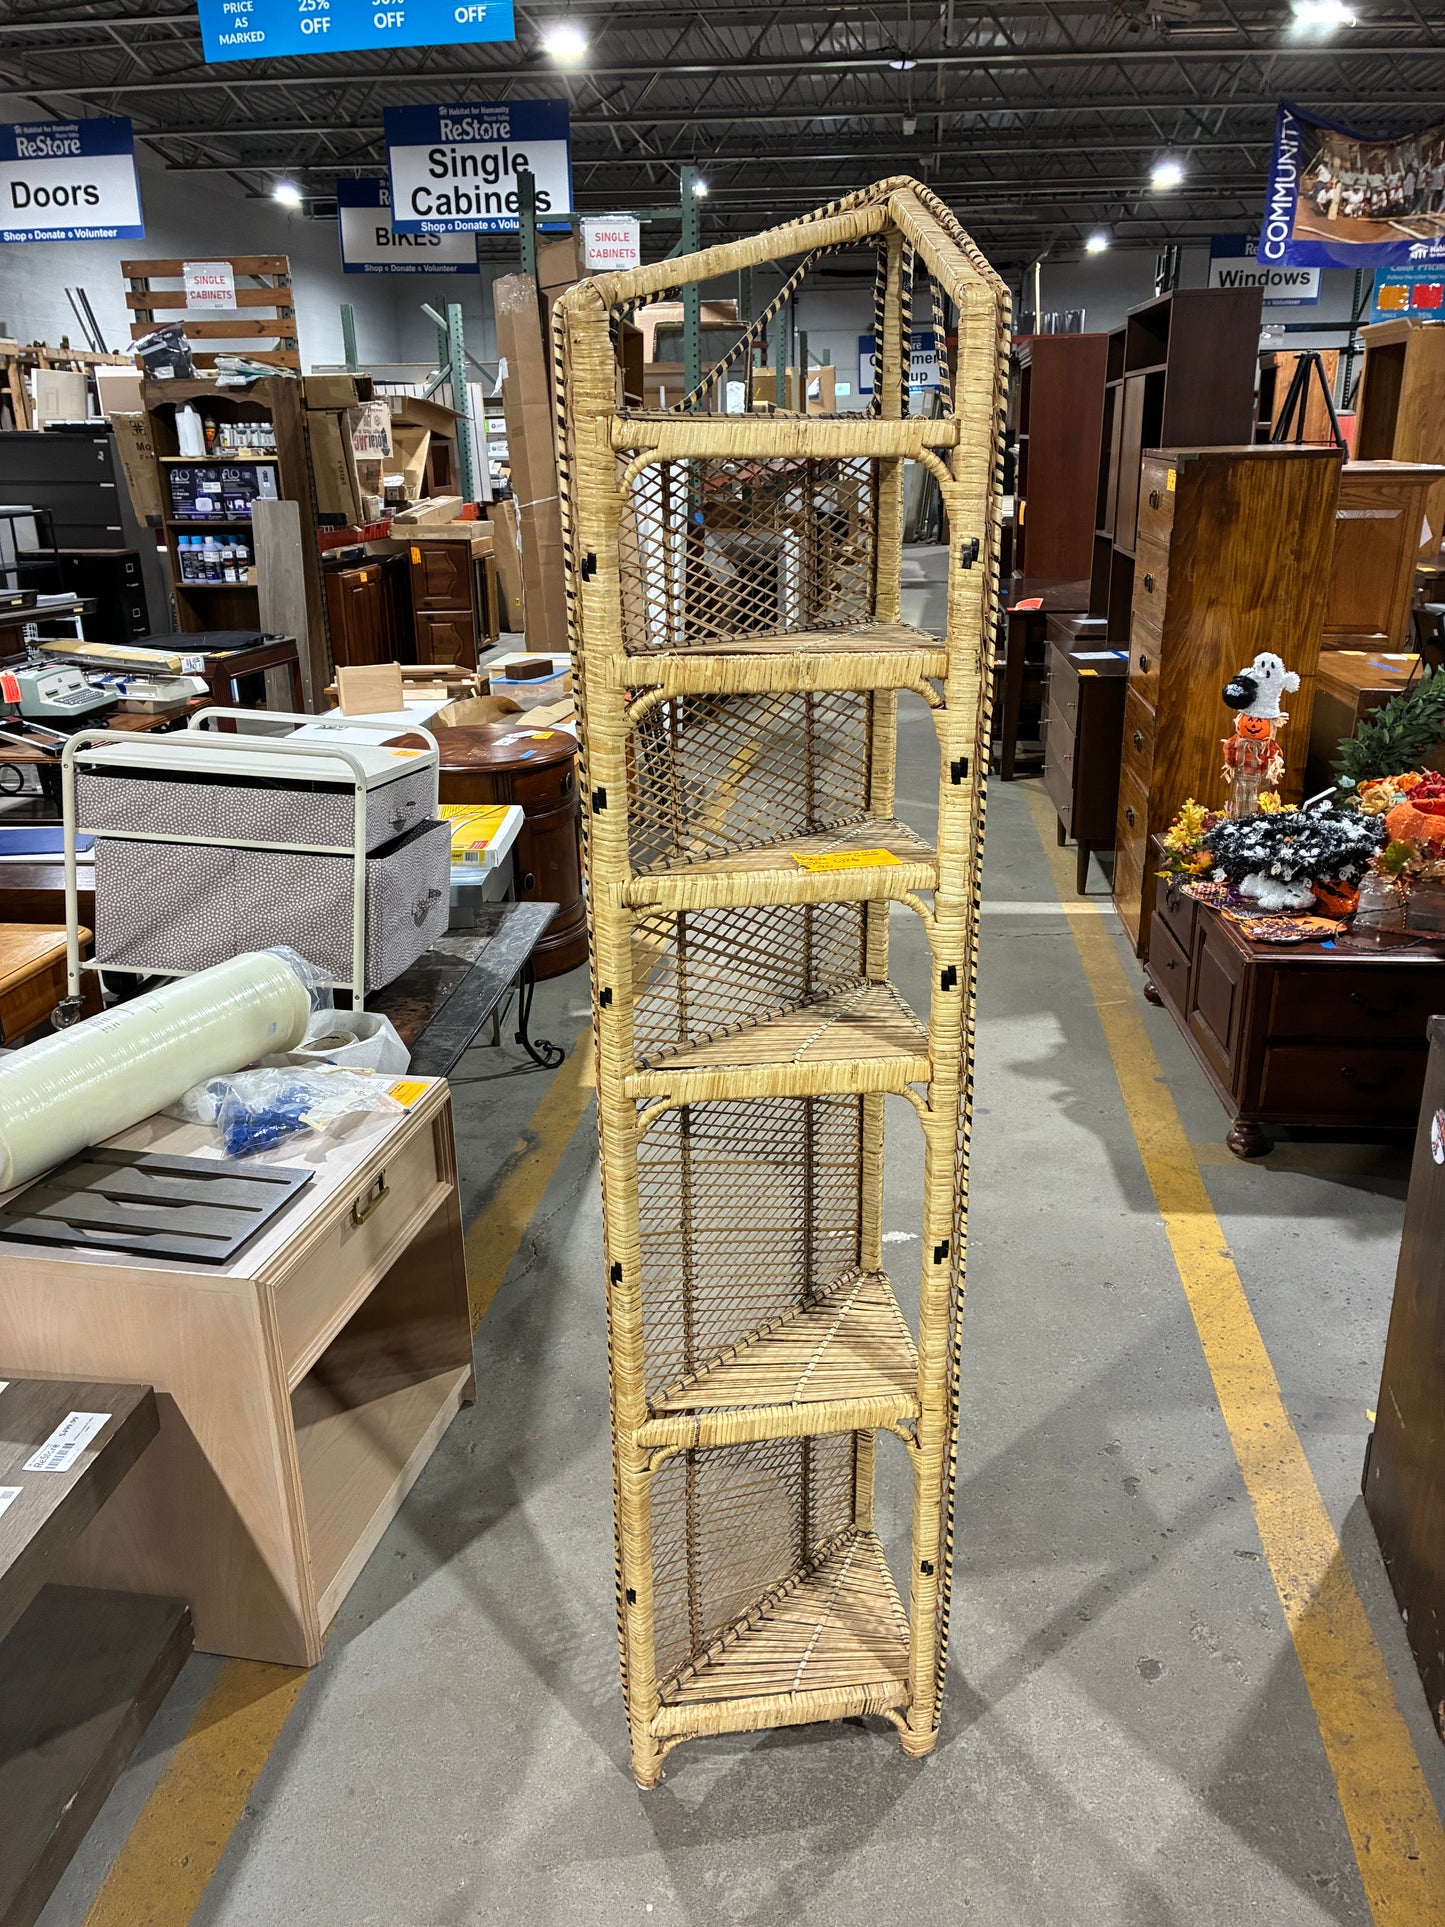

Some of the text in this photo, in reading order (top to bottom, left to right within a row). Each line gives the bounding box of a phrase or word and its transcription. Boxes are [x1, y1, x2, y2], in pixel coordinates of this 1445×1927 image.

[222, 1, 254, 13] PRICE
[298, 0, 330, 12] 25%
[373, 11, 405, 29] OFF
[454, 6, 487, 24] OFF
[234, 17, 249, 28] AS
[300, 17, 331, 35] OFF
[218, 31, 265, 45] MARKED
[448, 105, 510, 116] Habitat for Humanity
[440, 117, 511, 141] ReStore
[16, 135, 81, 157] ReStore
[428, 146, 529, 184] Single
[1264, 109, 1300, 259] COMMUNITY
[10, 181, 100, 208] Doors
[411, 185, 552, 216] Cabines
[421, 221, 446, 233] Shop
[454, 219, 488, 231] Donate
[3, 228, 118, 242] Shop Donate Volunteer
[375, 228, 441, 247] BIKES
[595, 232, 630, 242] SINGLE
[589, 248, 636, 258] CABINETS
[364, 264, 458, 273] Shop Donate Volunteer
[193, 275, 225, 285] SINGLE
[1219, 269, 1310, 287] Windows
[190, 290, 233, 300] CABINETS
